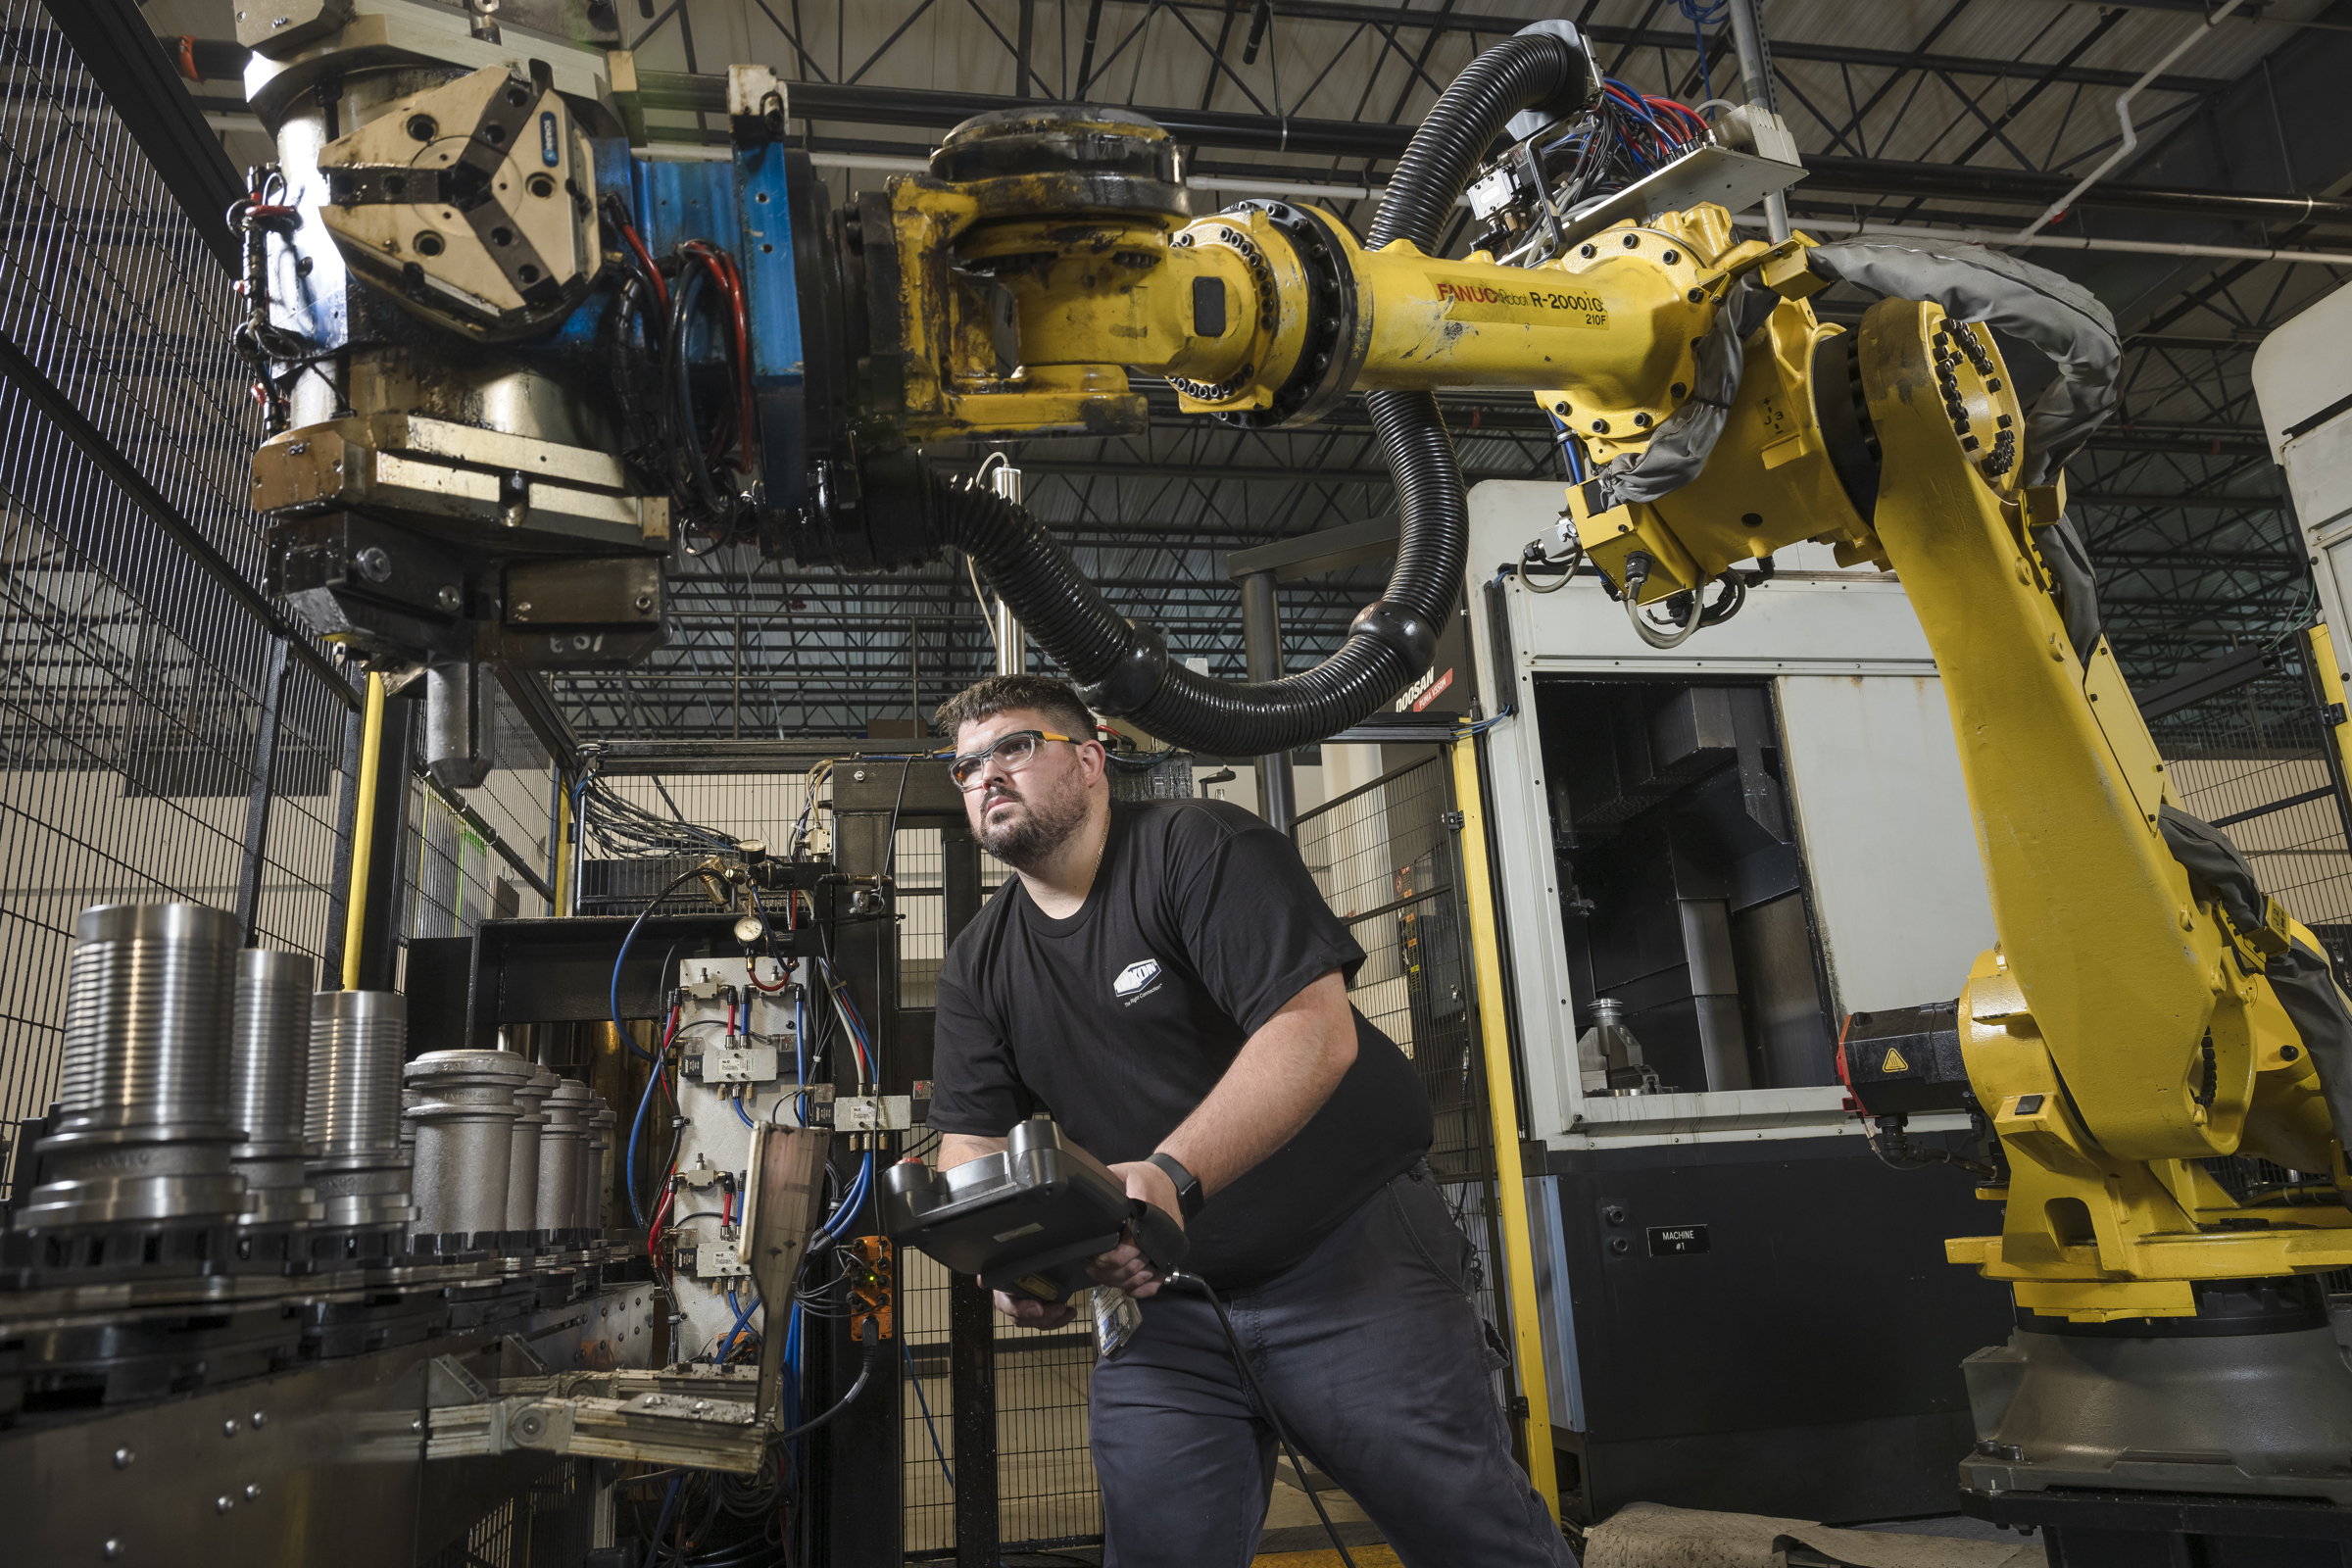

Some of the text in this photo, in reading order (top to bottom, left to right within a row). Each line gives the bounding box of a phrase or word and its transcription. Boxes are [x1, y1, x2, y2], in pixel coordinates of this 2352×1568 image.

[1436, 282, 1498, 304] FANUC
[1586, 314, 1606, 326] 210F
[1396, 665, 1435, 712] DOOSAN
[1418, 691, 1433, 710] PUMA
[1115, 961, 1157, 994] DIXON
[1130, 995, 1140, 1004] Right
[1662, 1230, 1695, 1241] MACHINE
[1676, 1242, 1686, 1250] #1
